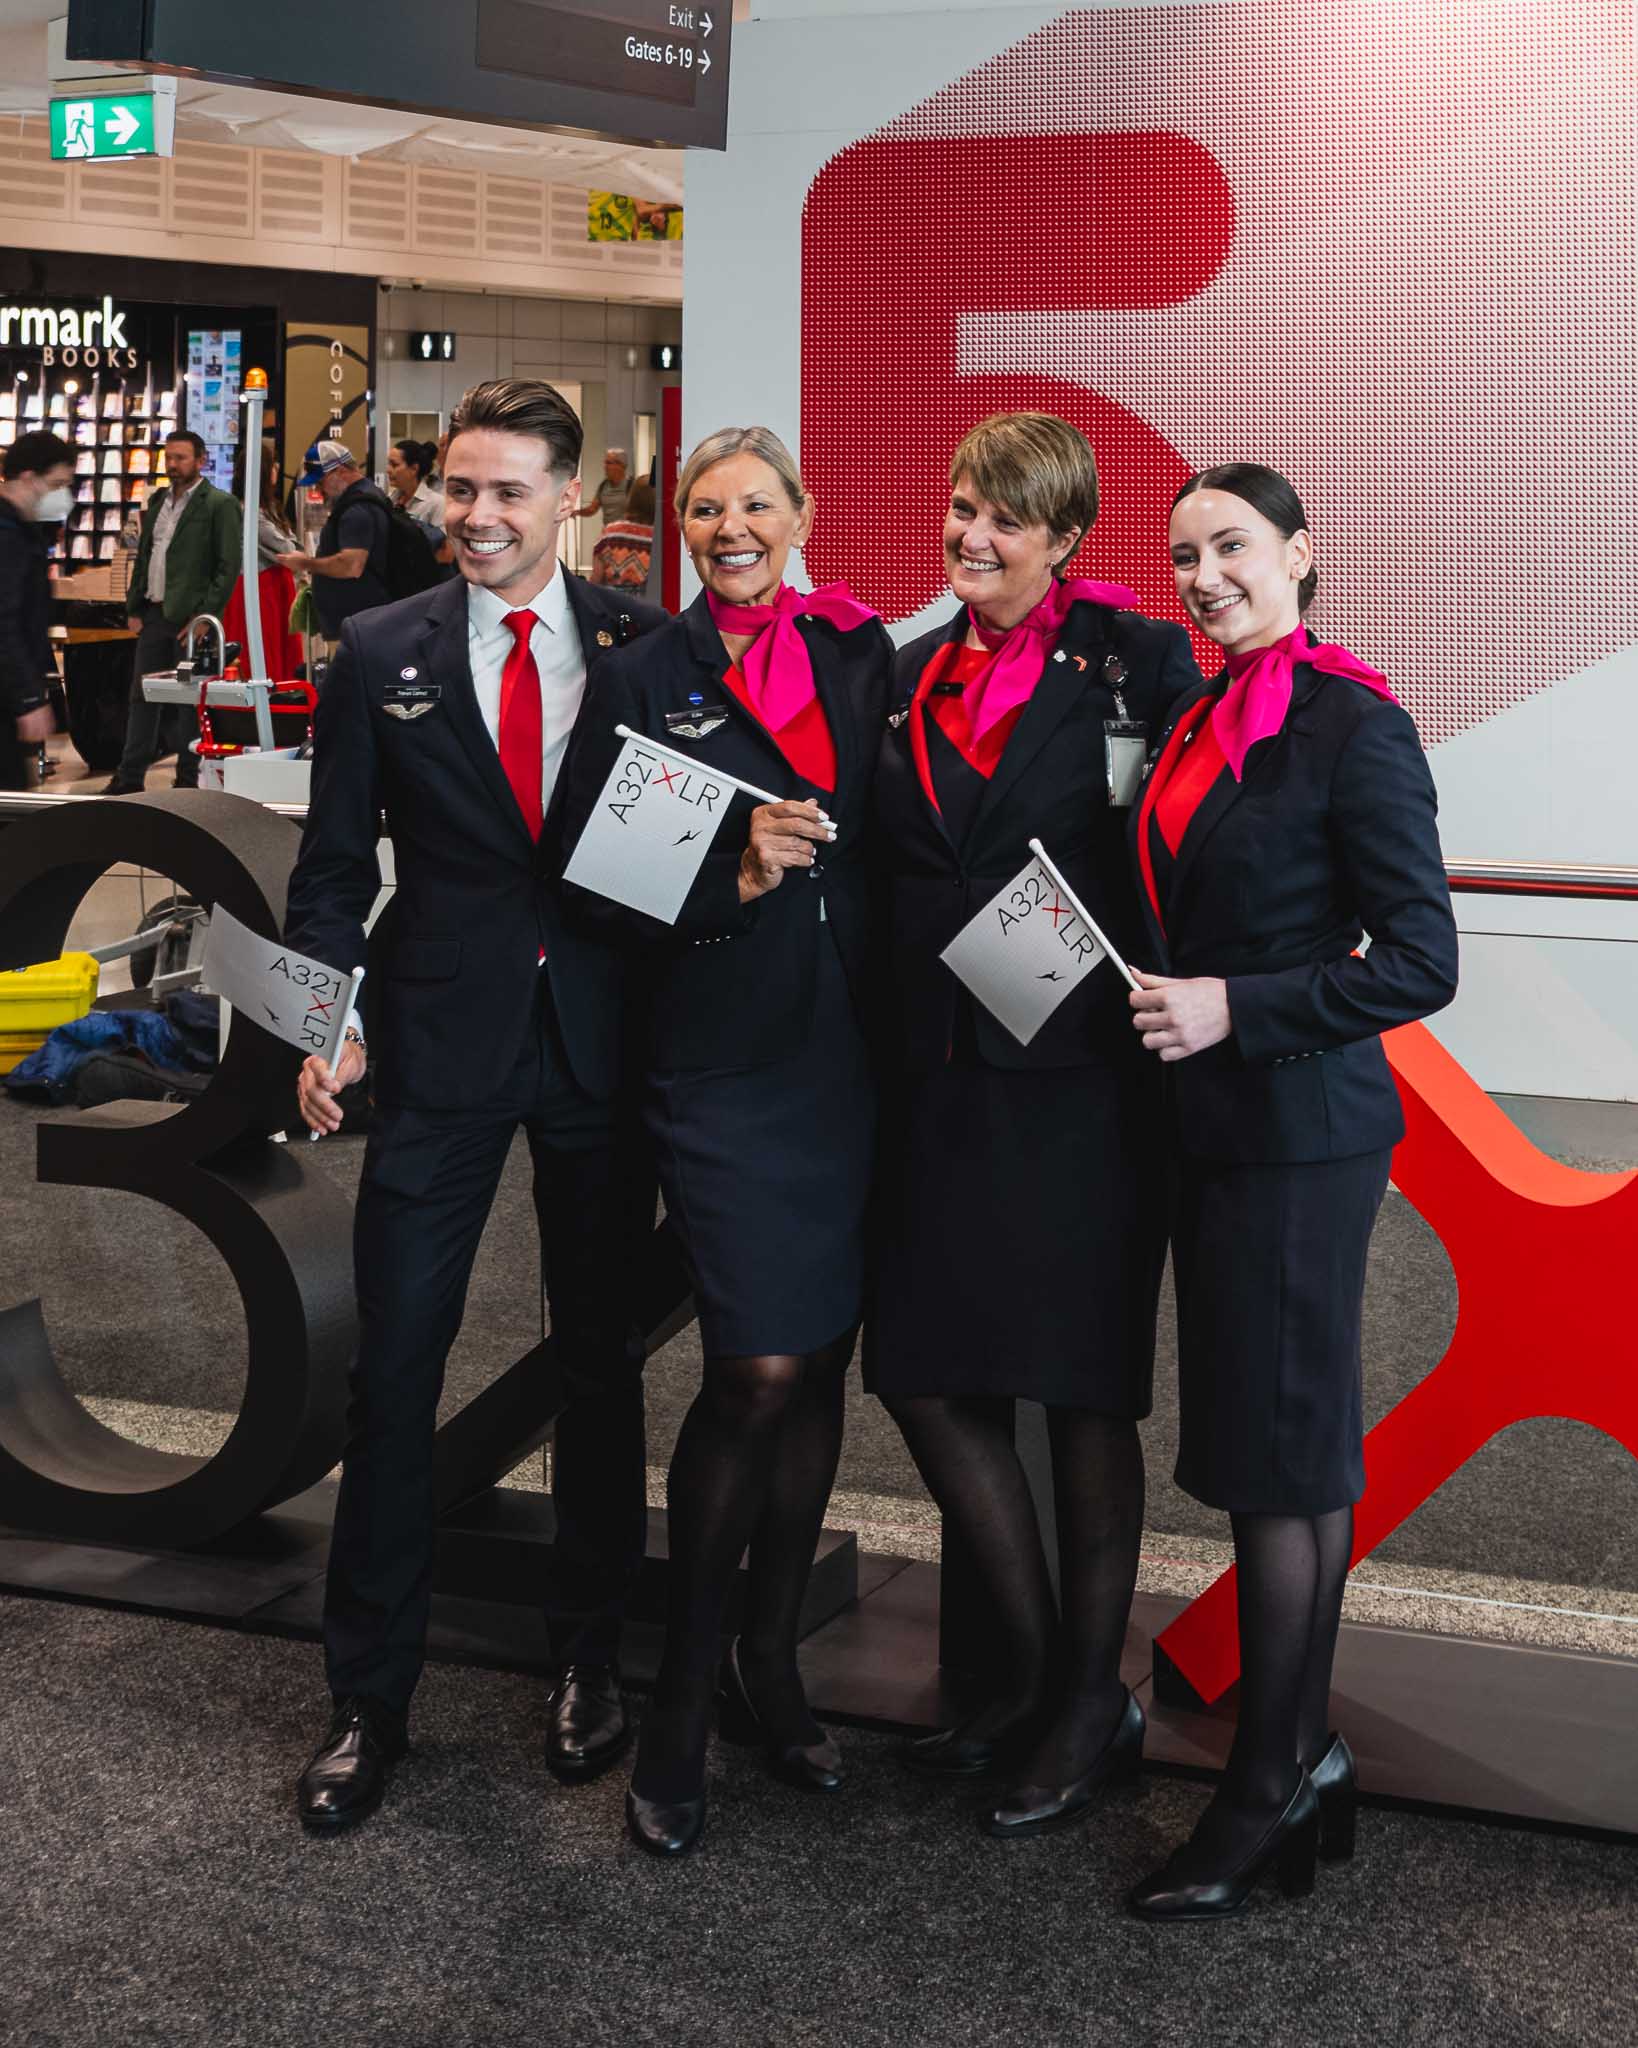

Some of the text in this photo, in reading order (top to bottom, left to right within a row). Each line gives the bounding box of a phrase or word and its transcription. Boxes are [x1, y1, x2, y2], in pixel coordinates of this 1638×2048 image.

[669, 4, 694, 29] Exit
[625, 36, 693, 68] Gates 6-19
[0, 295, 128, 348] rmark
[43, 346, 137, 368] BOOKS
[329, 340, 343, 438] COFFE
